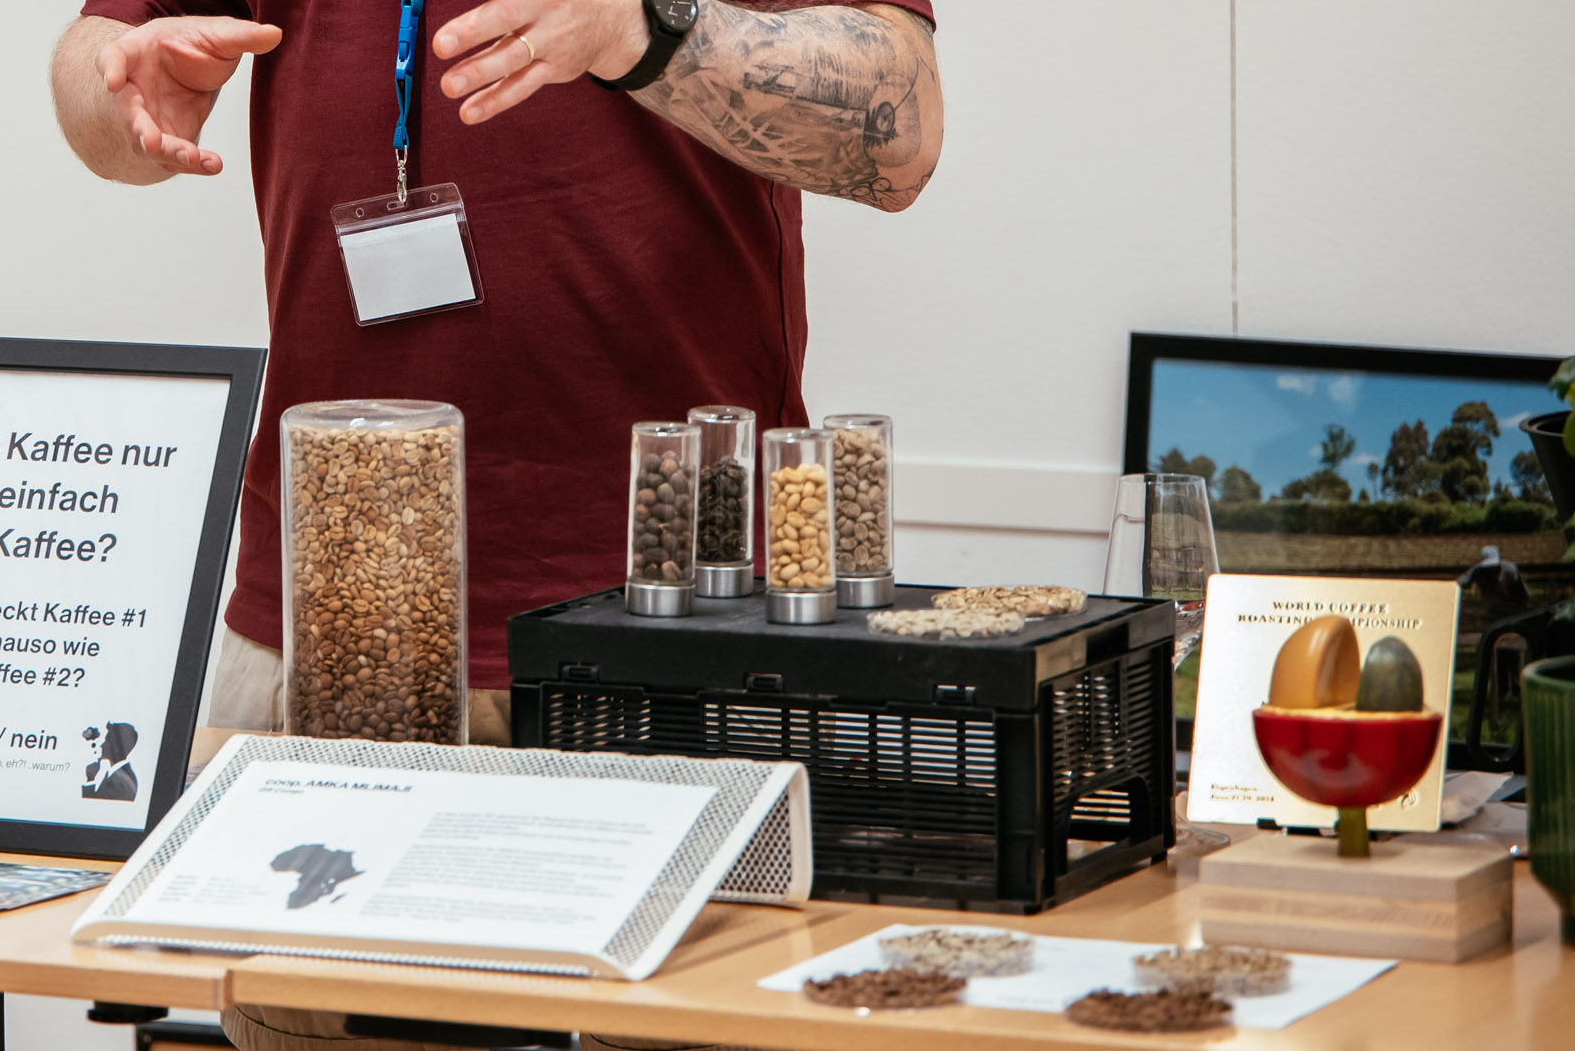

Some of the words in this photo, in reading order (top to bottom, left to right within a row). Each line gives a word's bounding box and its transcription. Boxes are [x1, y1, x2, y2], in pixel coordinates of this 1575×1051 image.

[7, 432, 113, 464] Kaffee
[121, 445, 177, 467] nur
[44, 603, 115, 625] Kaffee
[122, 609, 146, 627] #1
[1272, 601, 1324, 611] WORLD
[1329, 602, 1387, 614] COFFEE
[64, 637, 99, 656] wie
[43, 668, 85, 687] #2?
[11, 730, 57, 750] nein
